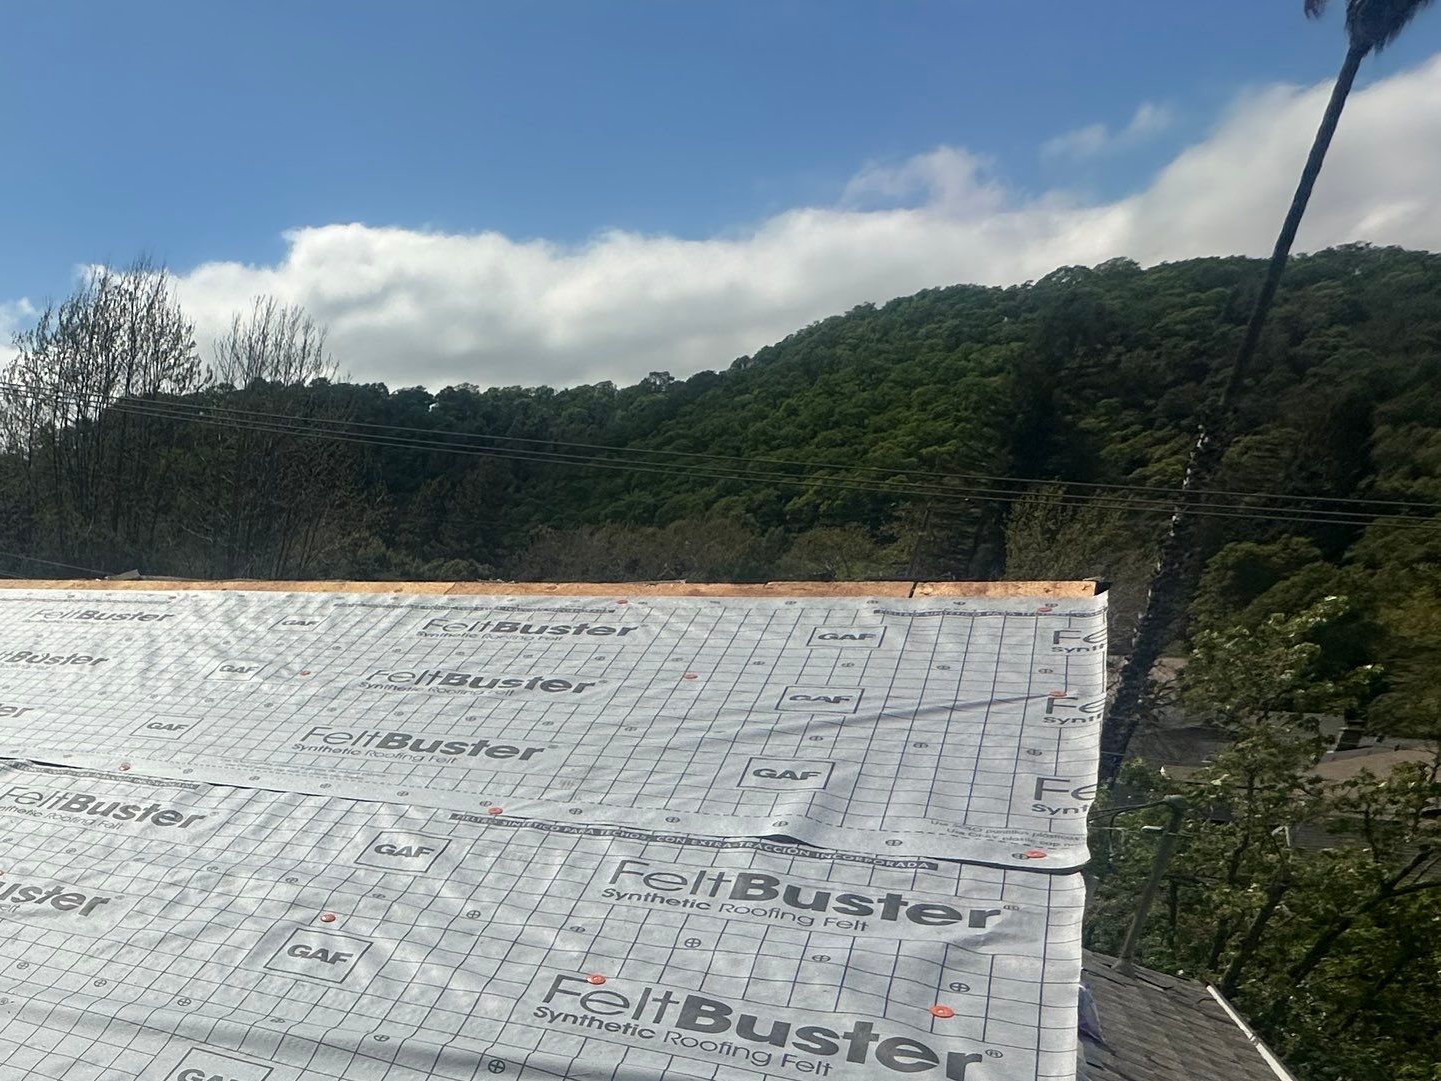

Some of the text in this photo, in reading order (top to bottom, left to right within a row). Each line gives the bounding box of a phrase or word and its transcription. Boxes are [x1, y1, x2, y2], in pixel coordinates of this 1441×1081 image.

[422, 618, 640, 637] FeltBuster
[818, 632, 877, 641] GAF
[218, 663, 260, 675] GAF
[366, 669, 604, 695] FeltBuster
[789, 694, 853, 704] GAF
[146, 722, 190, 734] GAF
[299, 726, 547, 761] FeltBuster
[752, 767, 821, 780] GAF
[374, 844, 435, 858] GAF
[601, 887, 869, 932] Synthetic Roofing Felt
[287, 944, 353, 966] GAF
[533, 1005, 833, 1077] Synthetic Roofing Felt
